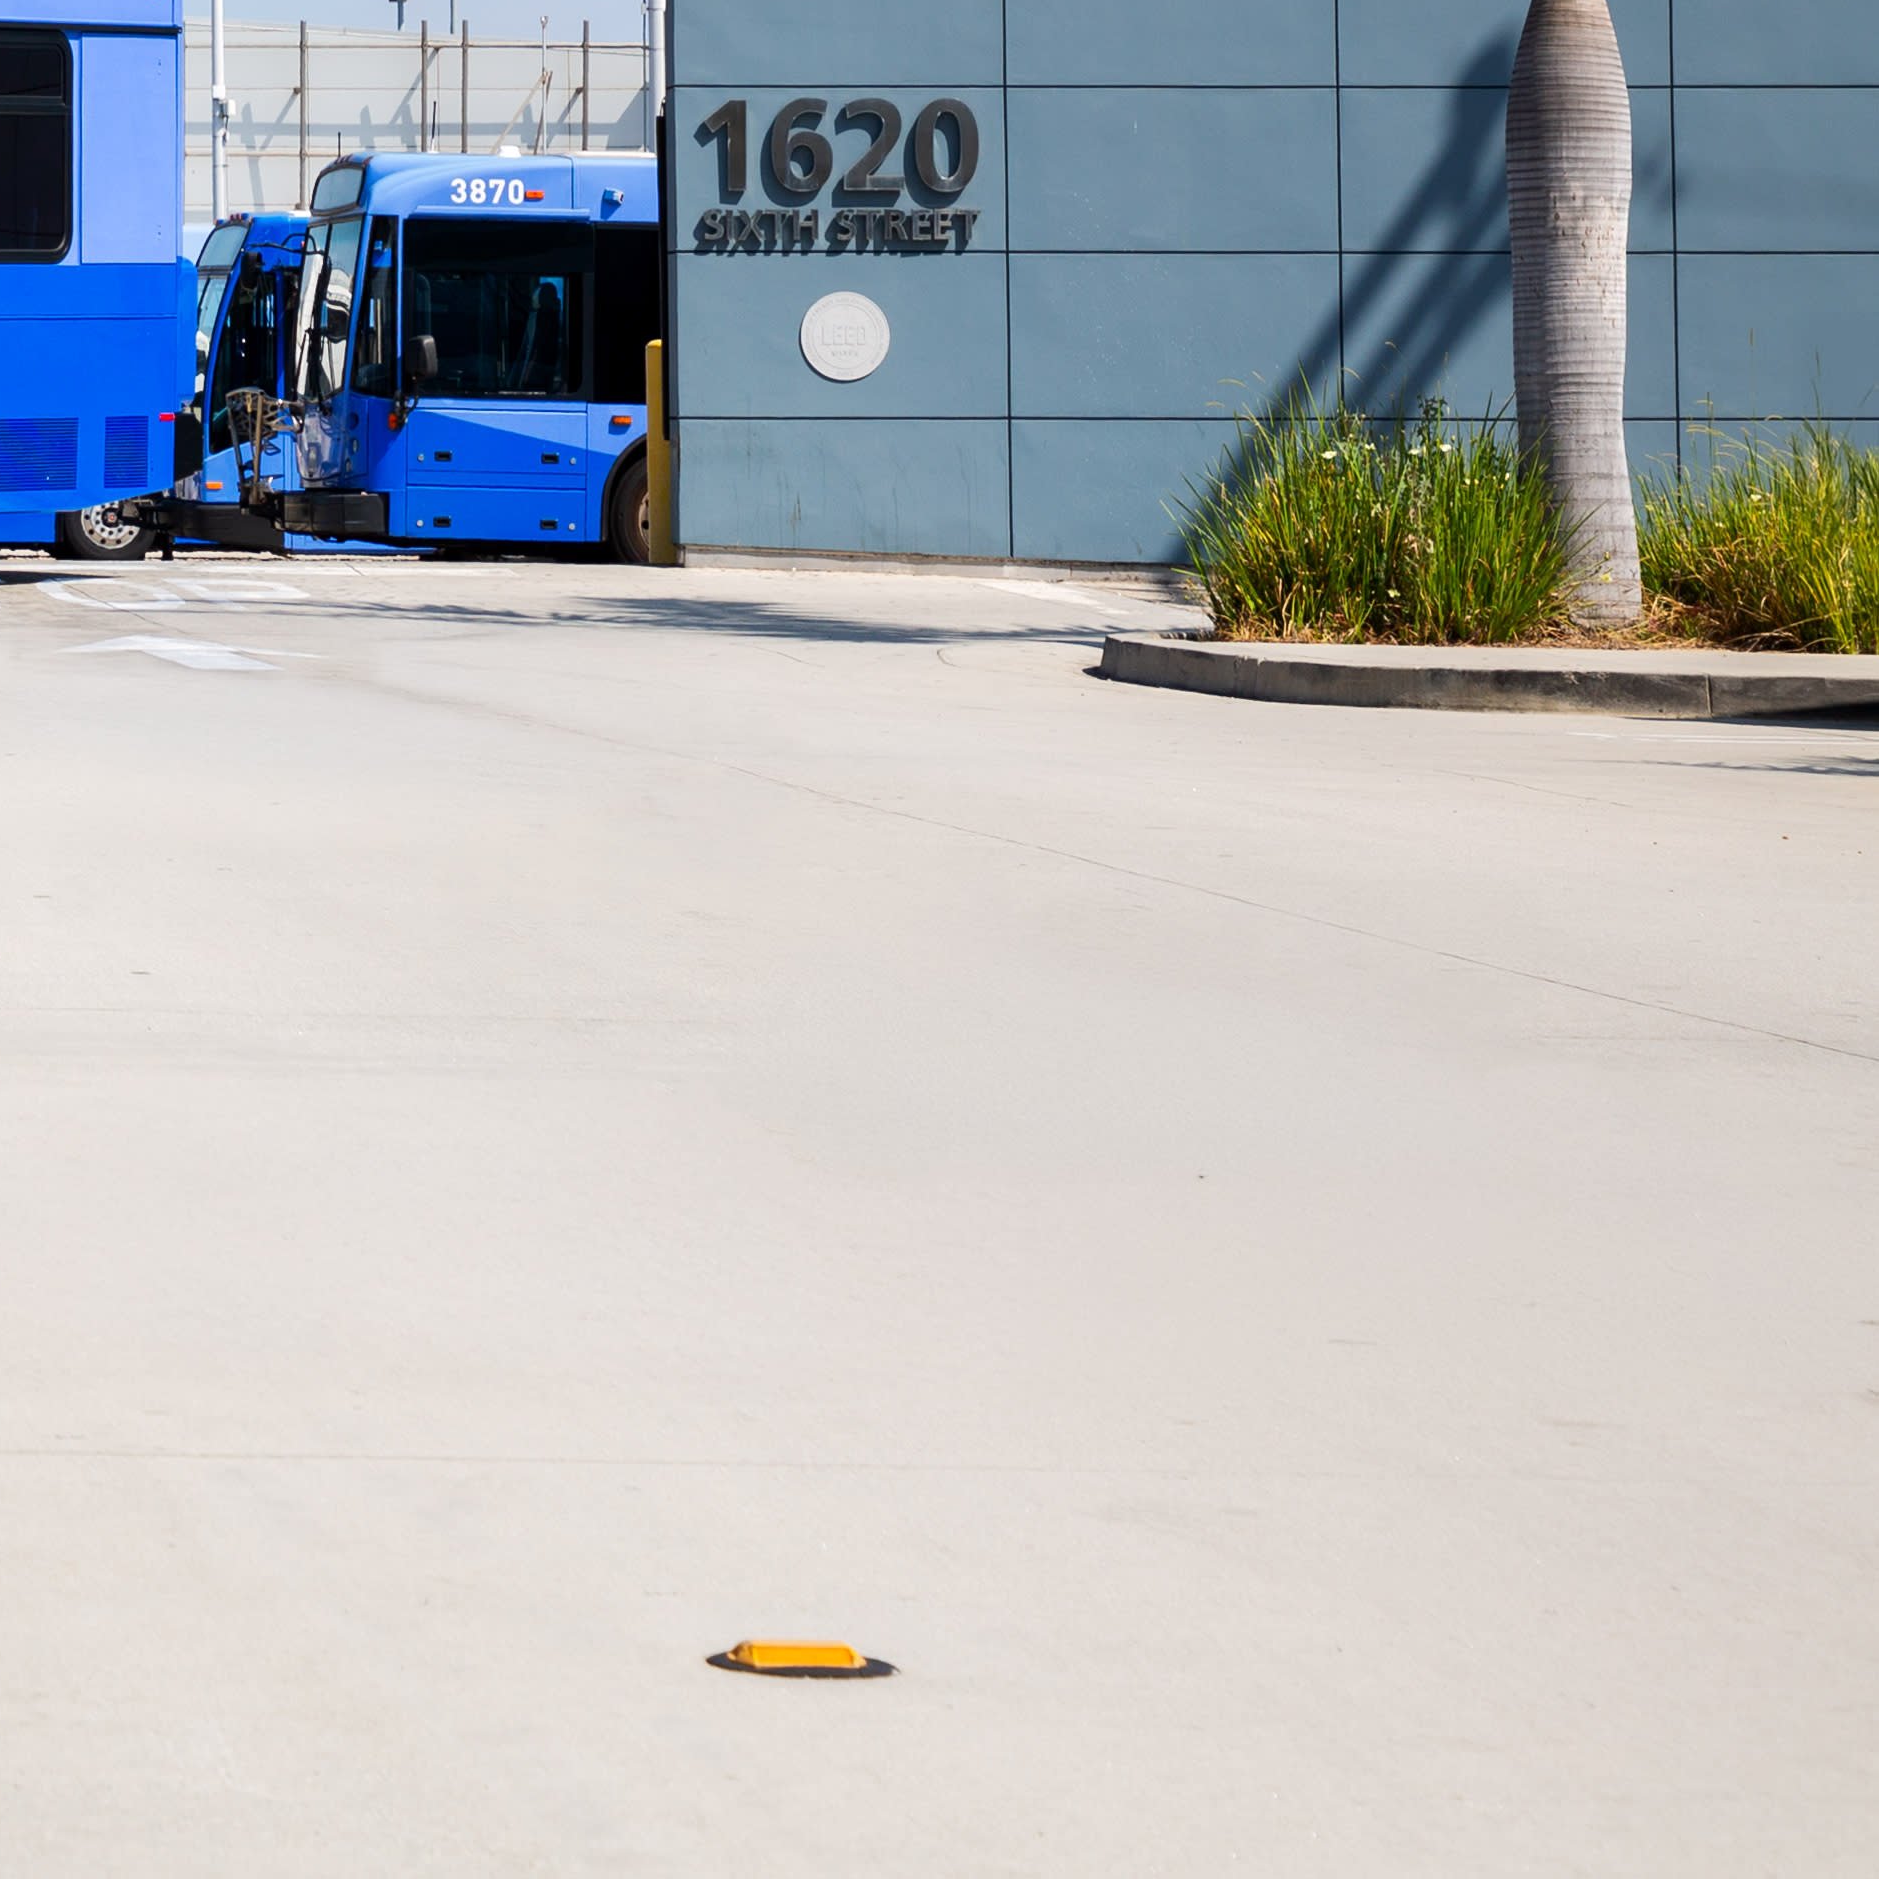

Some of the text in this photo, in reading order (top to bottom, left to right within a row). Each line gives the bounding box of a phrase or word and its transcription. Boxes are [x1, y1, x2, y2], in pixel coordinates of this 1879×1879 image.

[704, 97, 979, 192] 1620
[450, 177, 525, 205] 3870
[703, 208, 981, 241] SIXTH STREET
